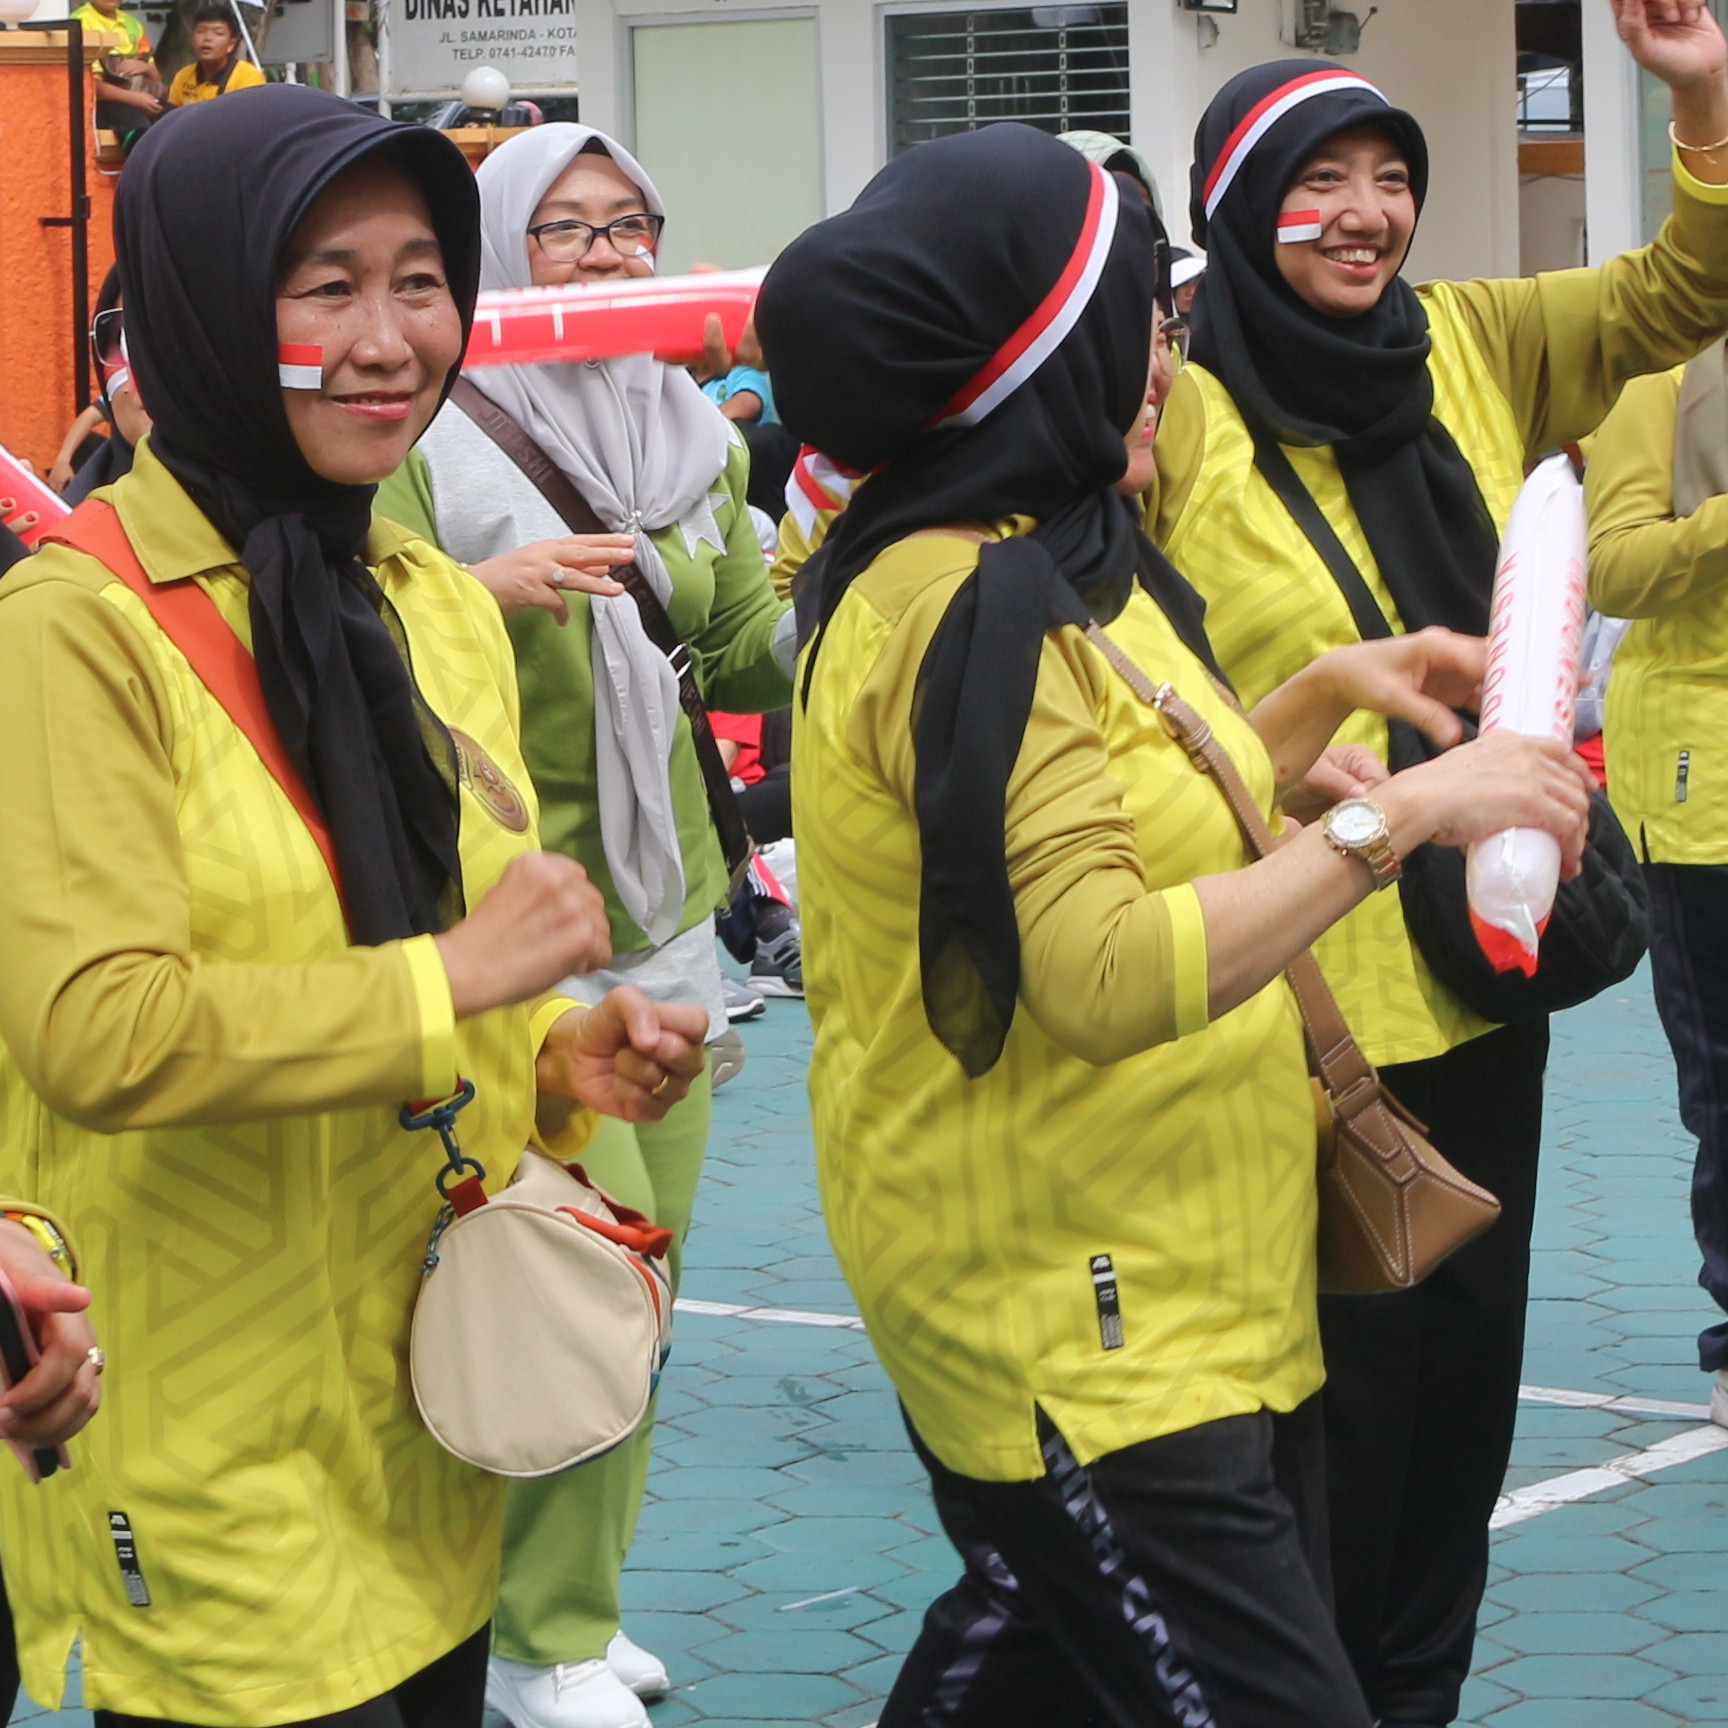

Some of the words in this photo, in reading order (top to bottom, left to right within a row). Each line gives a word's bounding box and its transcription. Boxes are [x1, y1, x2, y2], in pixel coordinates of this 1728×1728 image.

[439, 32, 456, 44] JL.
[460, 28, 536, 42] SAMARINDA
[452, 48, 485, 60] TELP.
